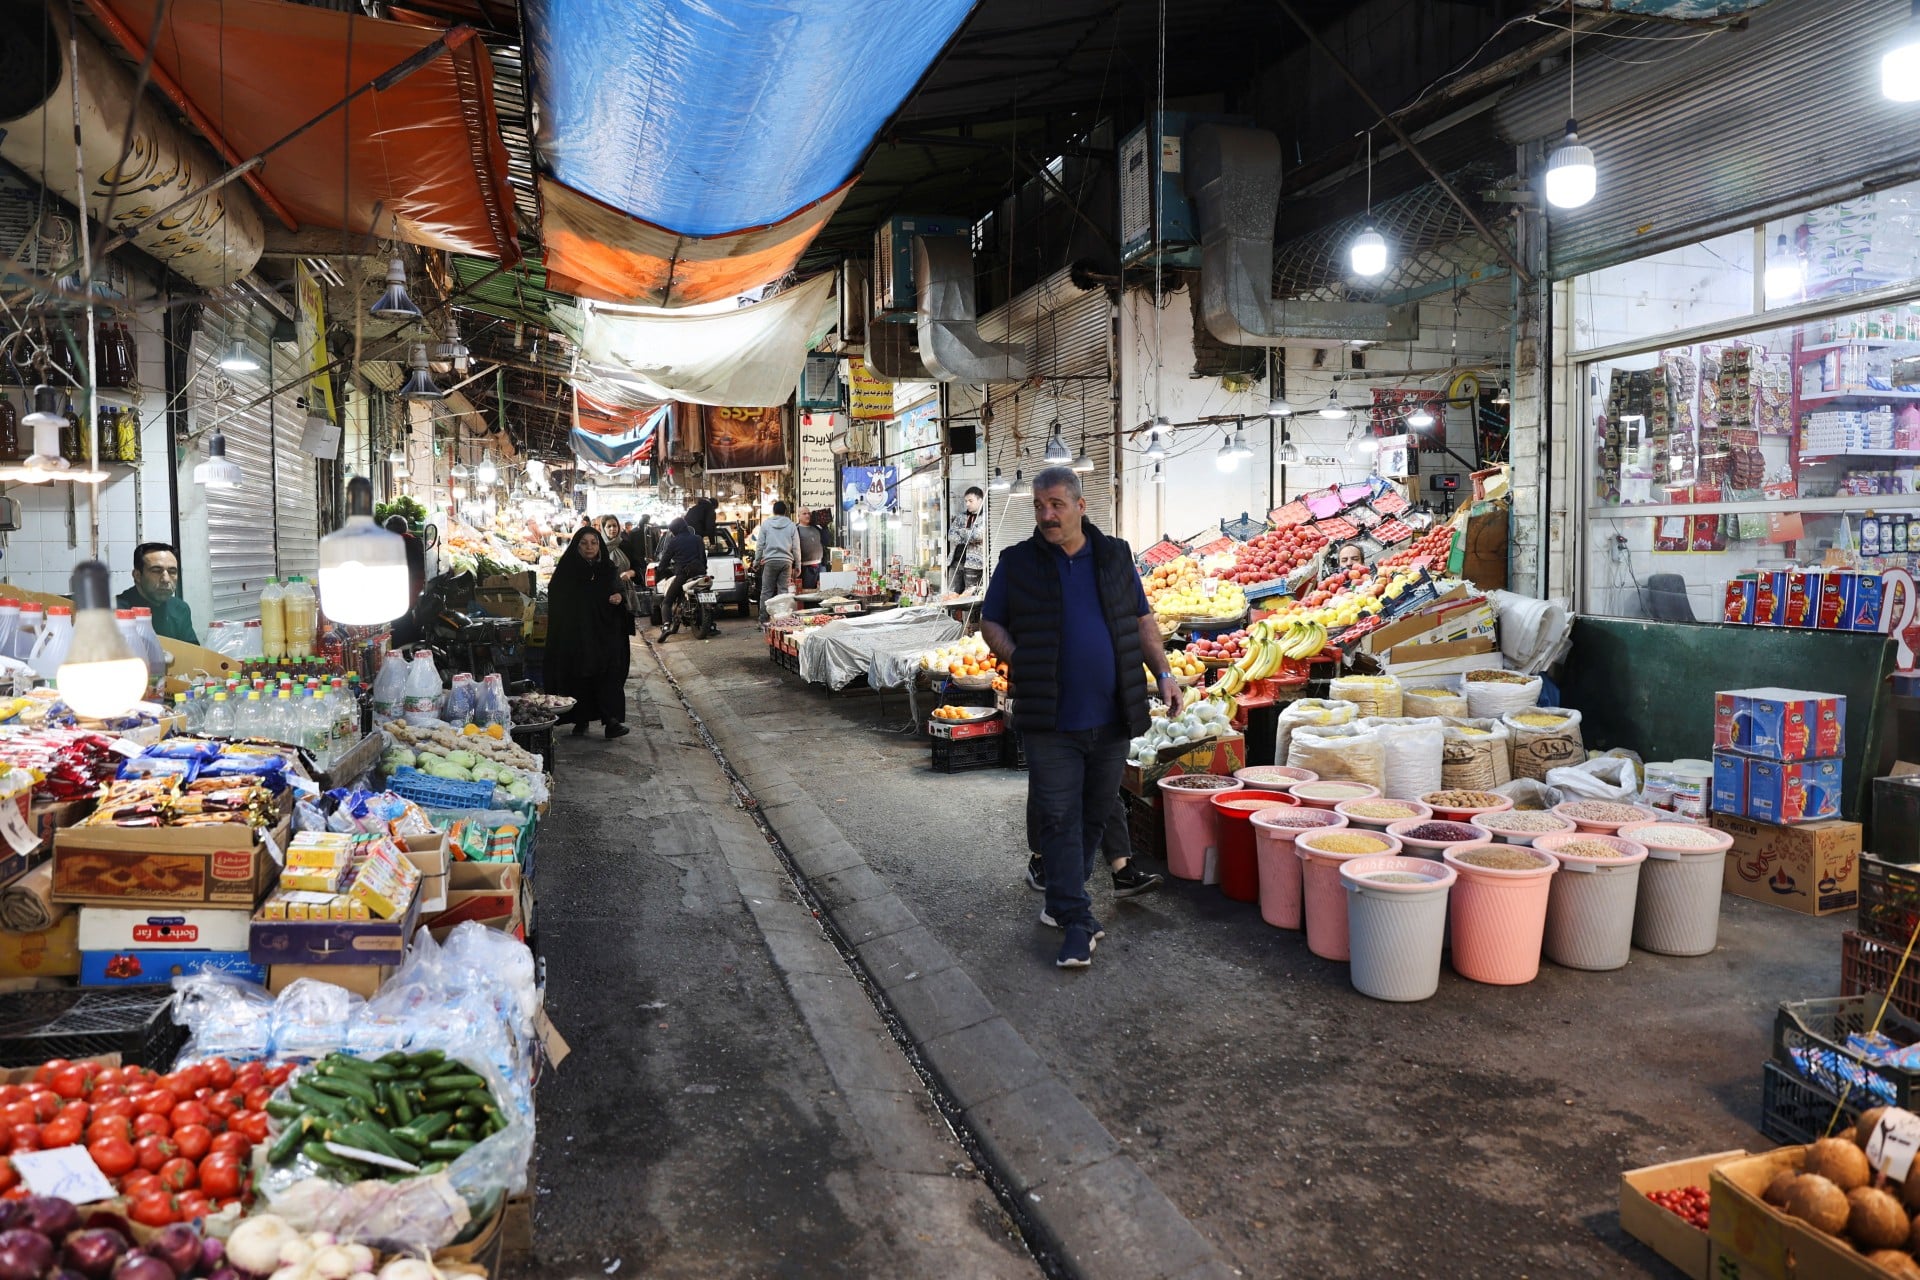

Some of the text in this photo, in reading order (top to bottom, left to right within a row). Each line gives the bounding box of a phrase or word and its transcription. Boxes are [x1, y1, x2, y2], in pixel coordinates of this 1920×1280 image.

[1444, 747, 1465, 757] SA
[1540, 741, 1568, 753] ASA
[215, 868, 248, 878] Simorgh
